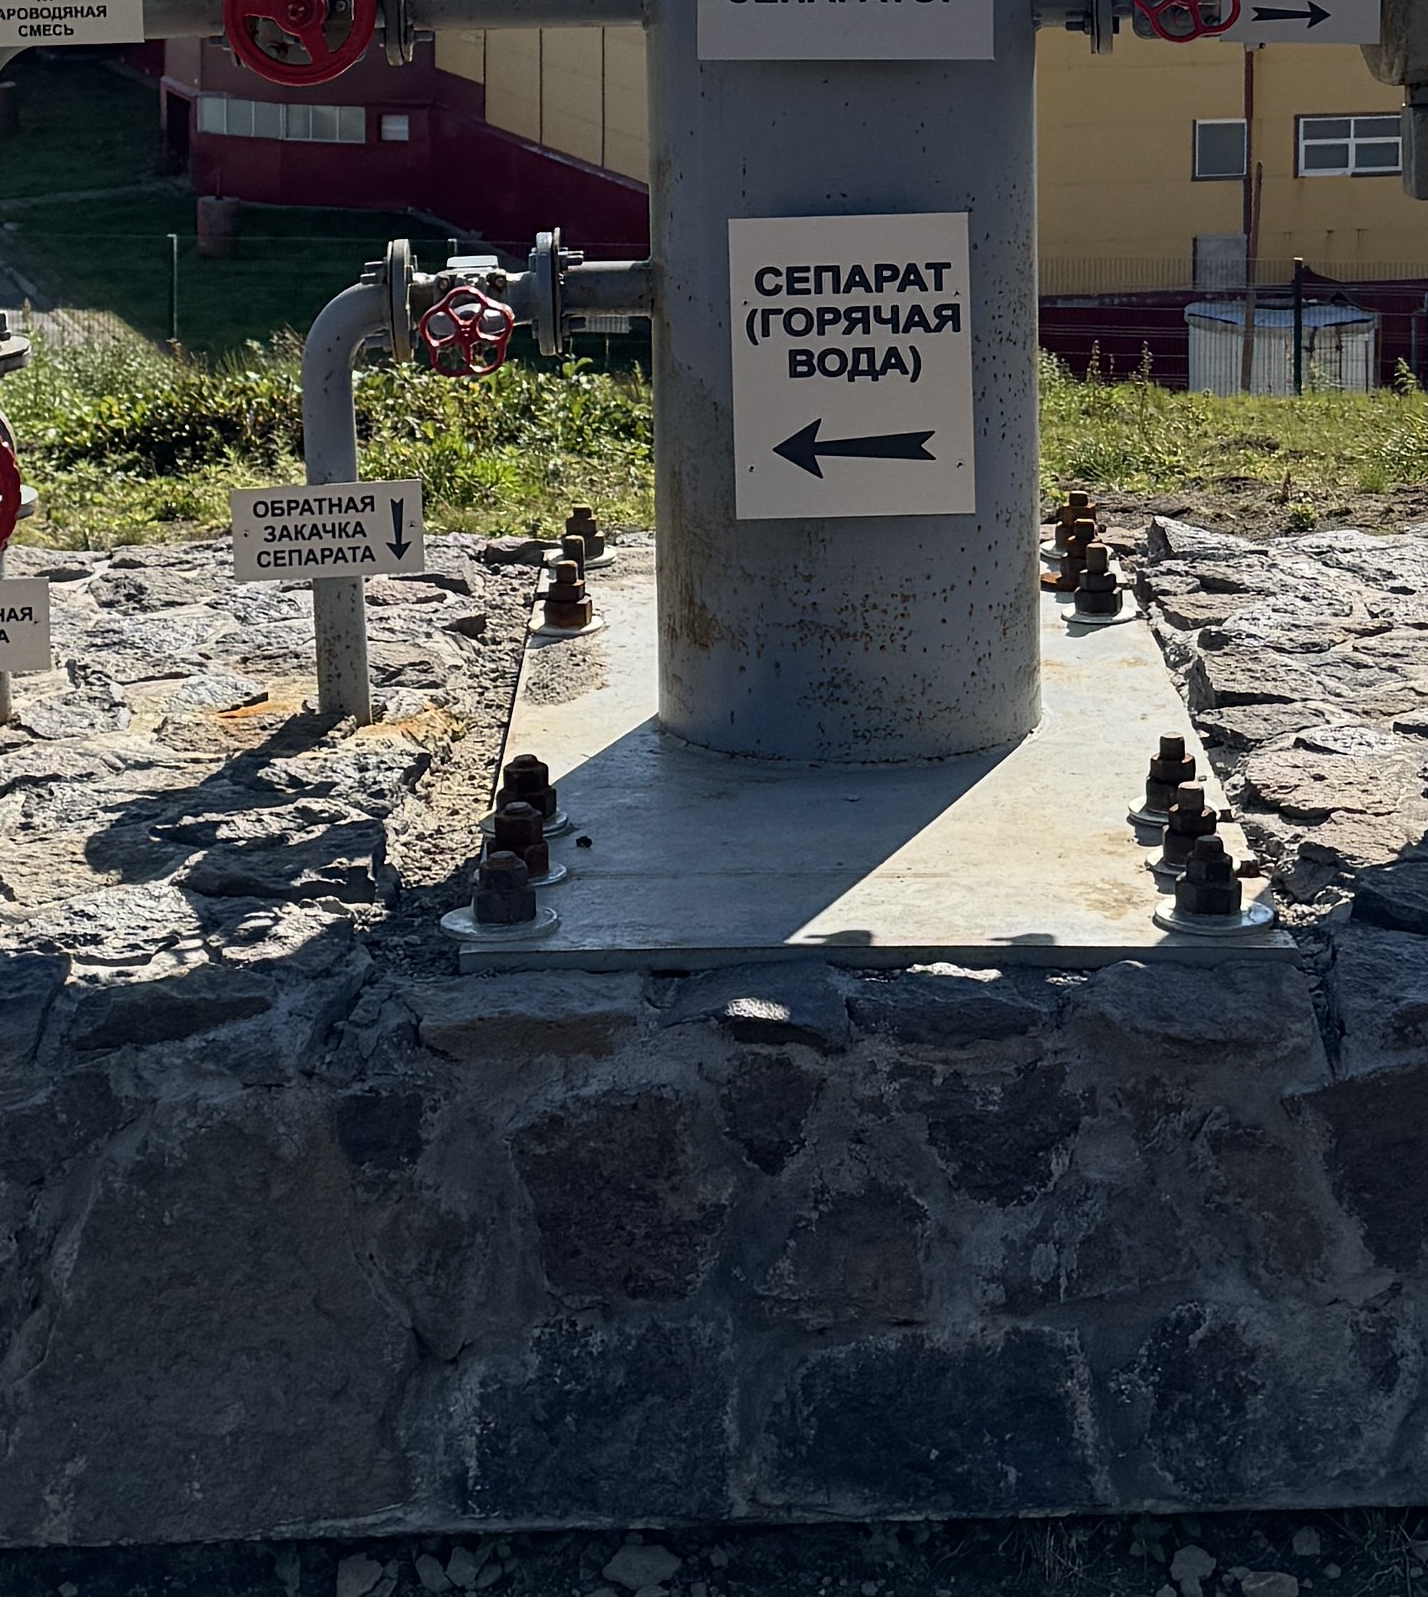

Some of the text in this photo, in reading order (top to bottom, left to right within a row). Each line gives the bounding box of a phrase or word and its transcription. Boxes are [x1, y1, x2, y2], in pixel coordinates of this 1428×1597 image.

[17, 23, 75, 38] СМЕСЬ
[754, 261, 952, 297] СЕПАРАТ
[745, 302, 962, 346] (ГОРЯЧАЯ
[788, 346, 922, 383] ВОДА)
[252, 495, 376, 519] ОБРАТНАЯ
[263, 520, 368, 544] ЗАКАЧКА
[255, 546, 377, 570] СЕПАРАТА
